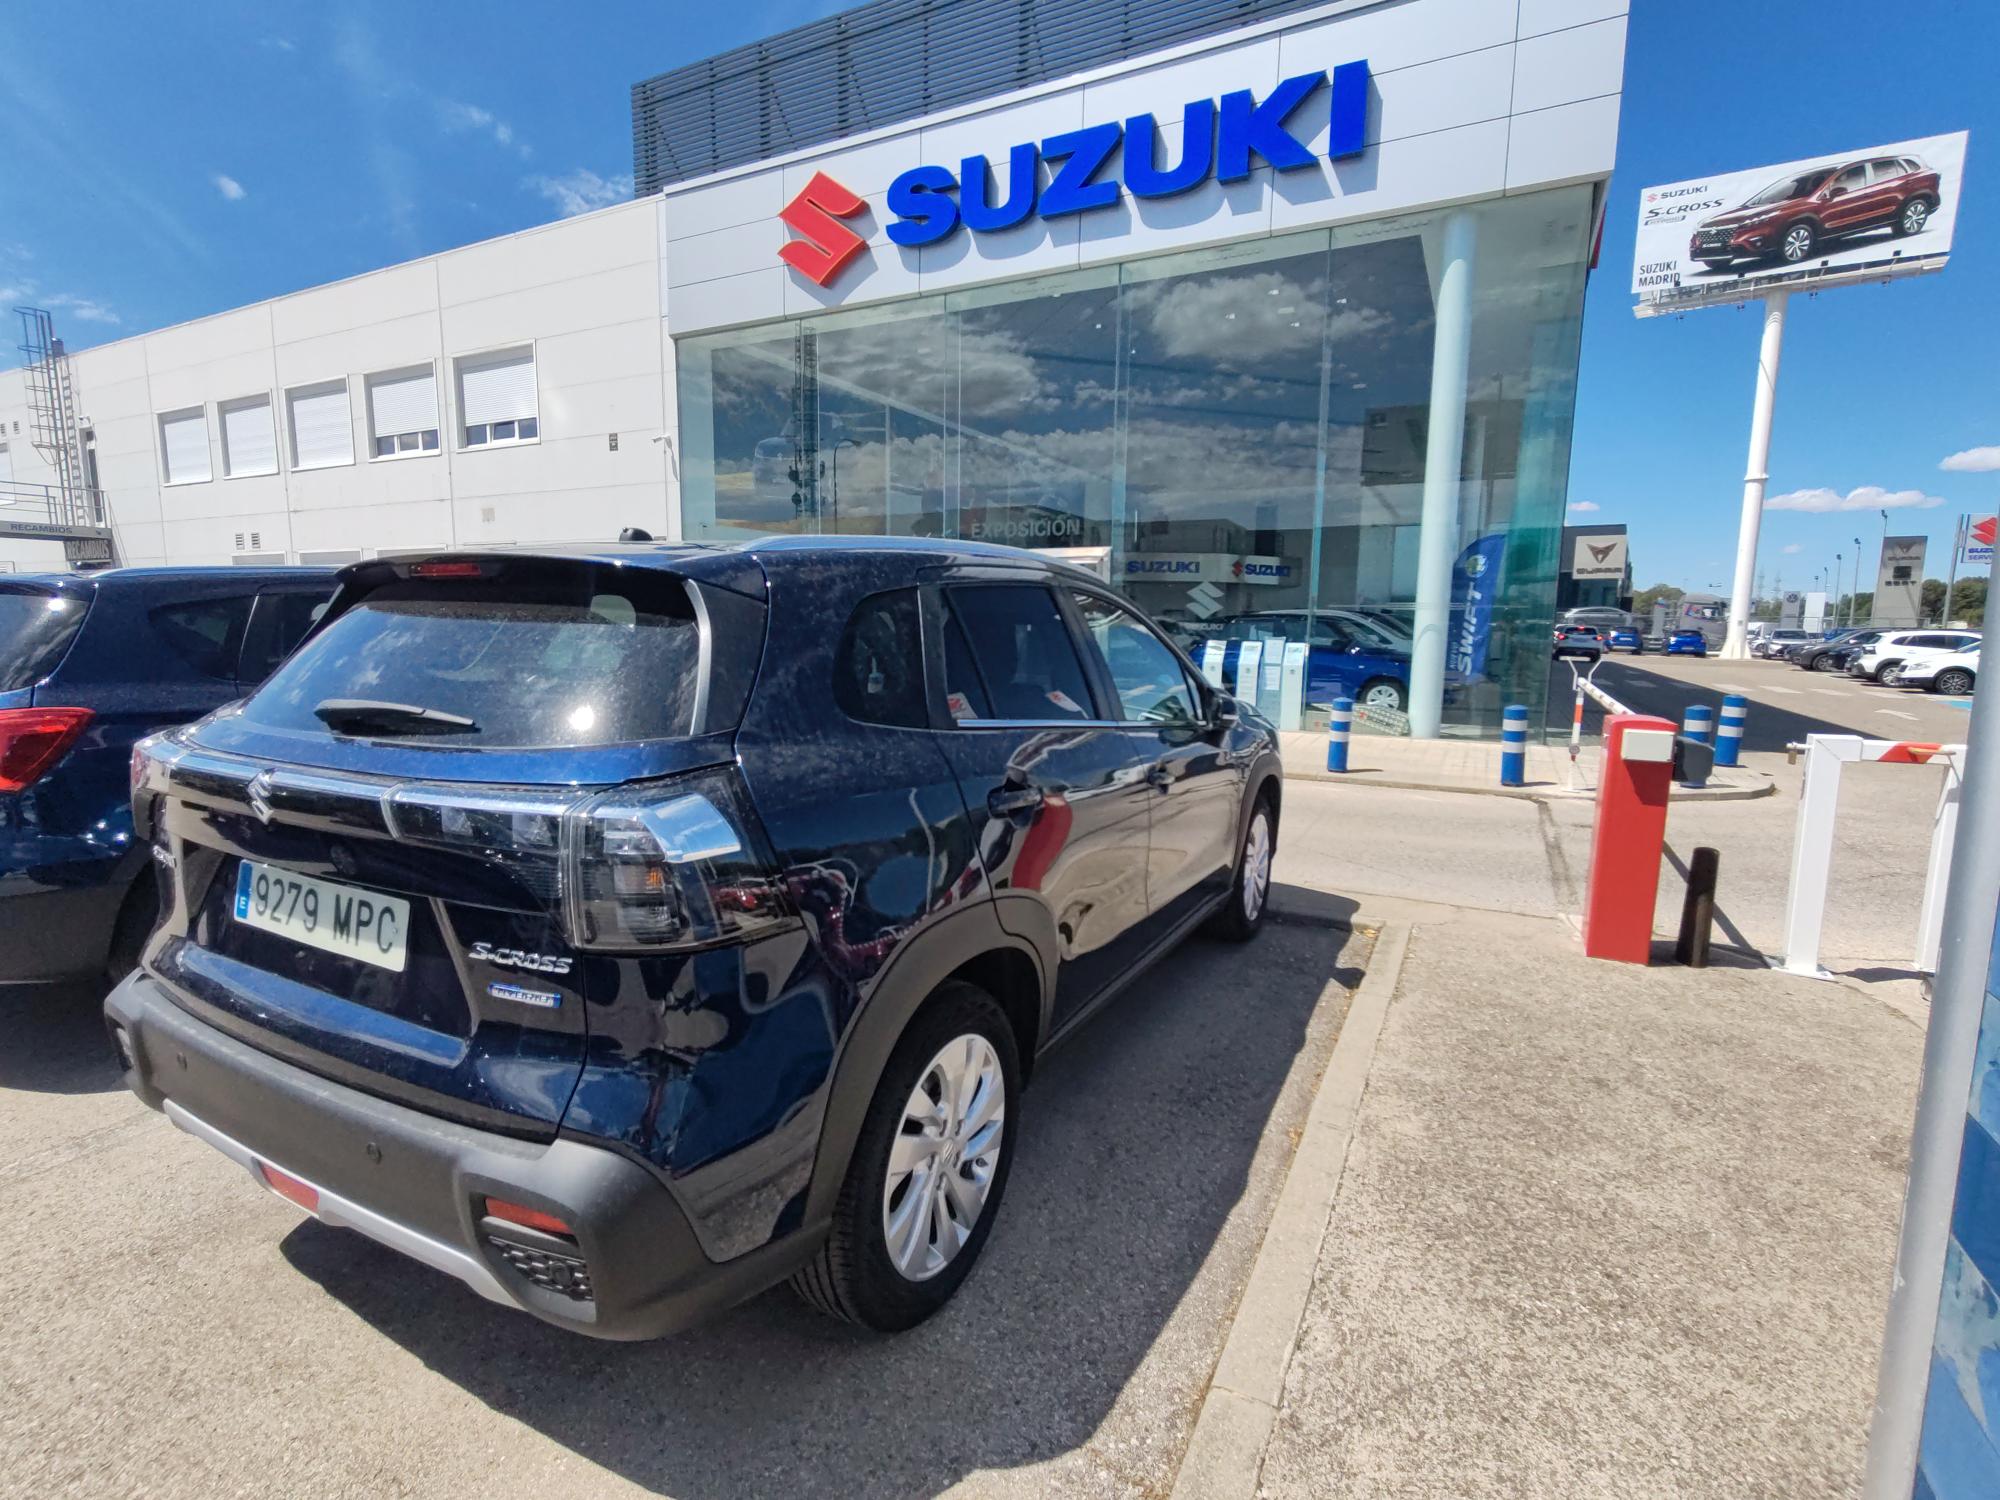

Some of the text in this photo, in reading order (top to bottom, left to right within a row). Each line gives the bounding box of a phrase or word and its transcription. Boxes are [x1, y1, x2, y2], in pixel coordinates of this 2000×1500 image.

[887, 59, 1370, 248] SUZUKI
[1661, 186, 1708, 199] SUZUKI
[1645, 199, 1724, 219] S-CROSS
[1640, 261, 1677, 275] SUZUKI
[1639, 273, 1680, 287] MADRID
[11, 523, 73, 534] RECAMBIOS
[971, 513, 1080, 538] EXPOSICIÓN
[67, 540, 110, 559] RECAMBIOS
[1127, 561, 1200, 574] SUZUKI
[1245, 563, 1290, 577] SUZUKI
[1457, 581, 1482, 676] SWIFT
[240, 896, 246, 909] E
[255, 873, 396, 953] 9279 MPC
[468, 941, 573, 974] S-CROSS
